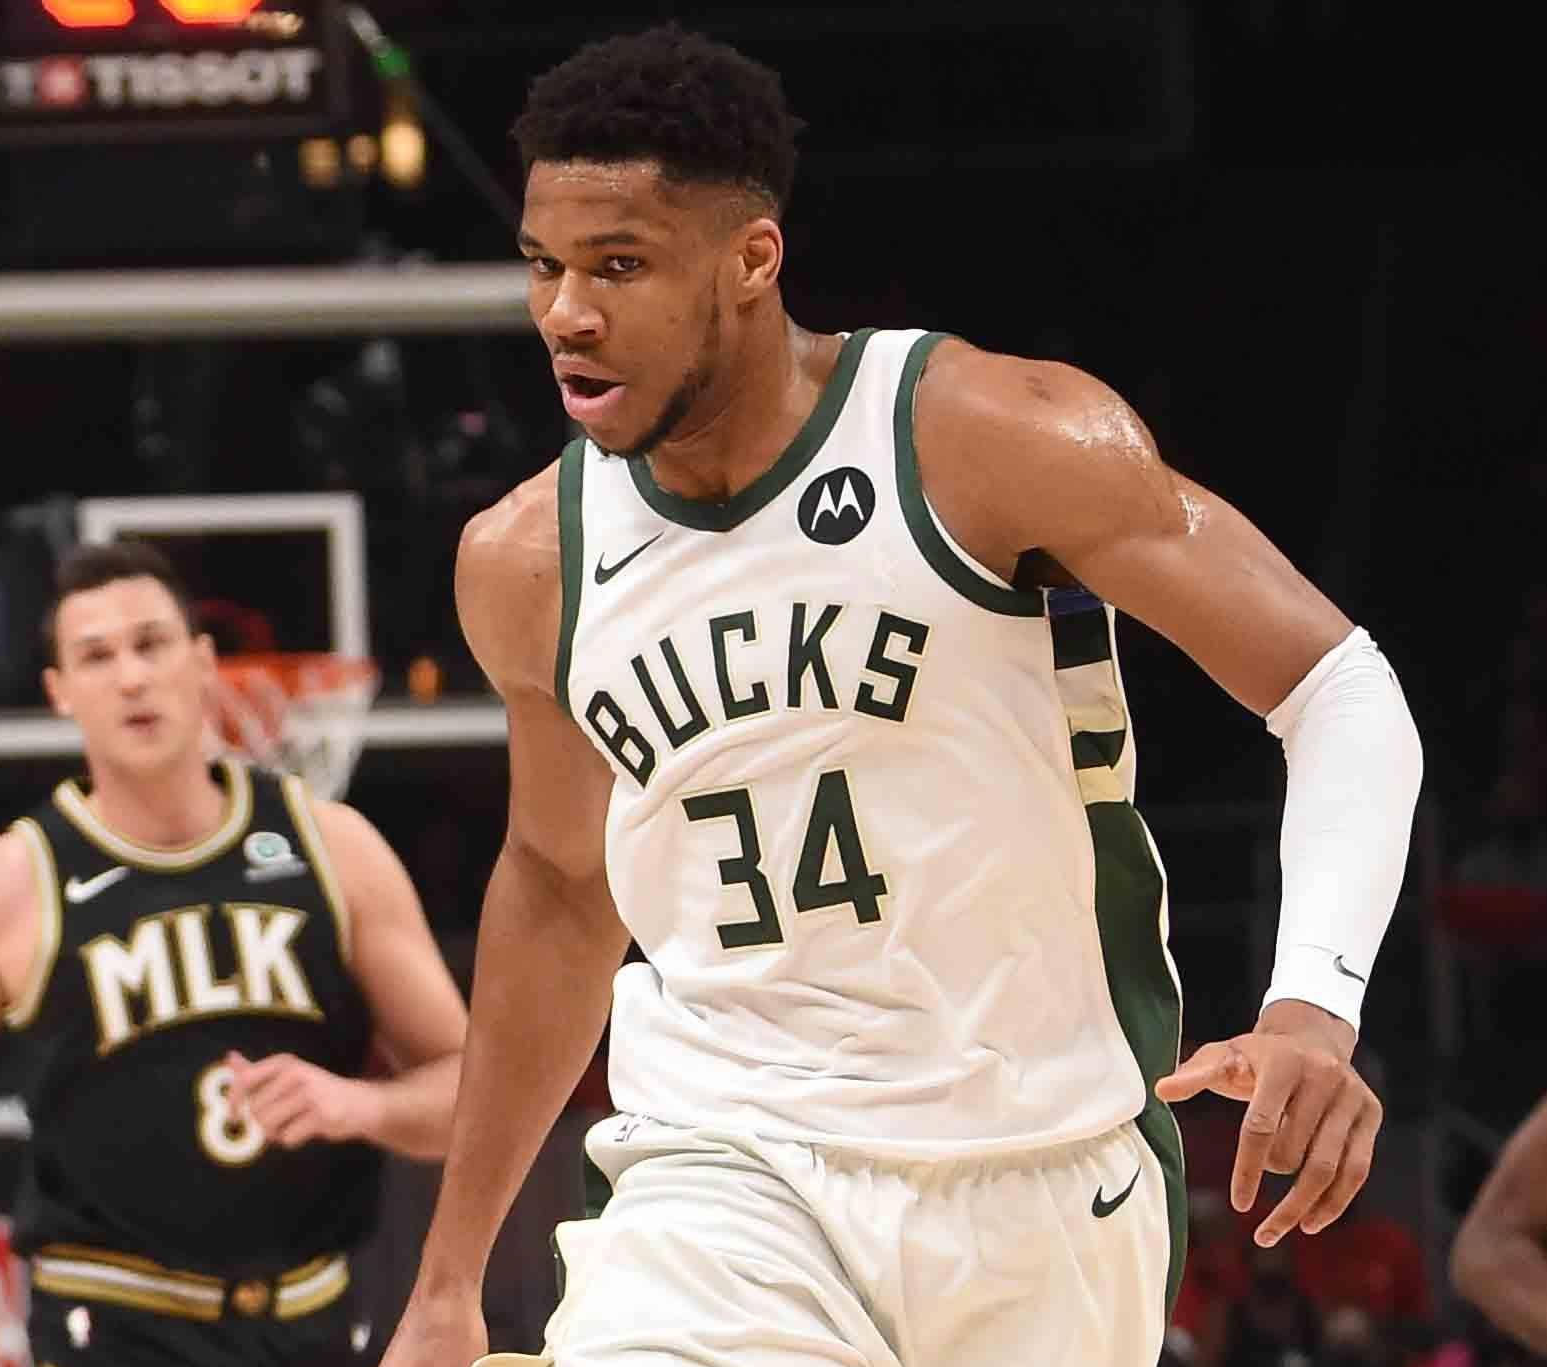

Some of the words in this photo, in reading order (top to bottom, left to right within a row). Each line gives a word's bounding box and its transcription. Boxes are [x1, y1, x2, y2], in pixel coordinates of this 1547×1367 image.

[86, 49, 319, 108] TISSOT
[584, 601, 930, 788] BUCKS
[680, 768, 888, 951] 34
[78, 902, 325, 1056] MLK
[198, 1063, 266, 1166] 8
